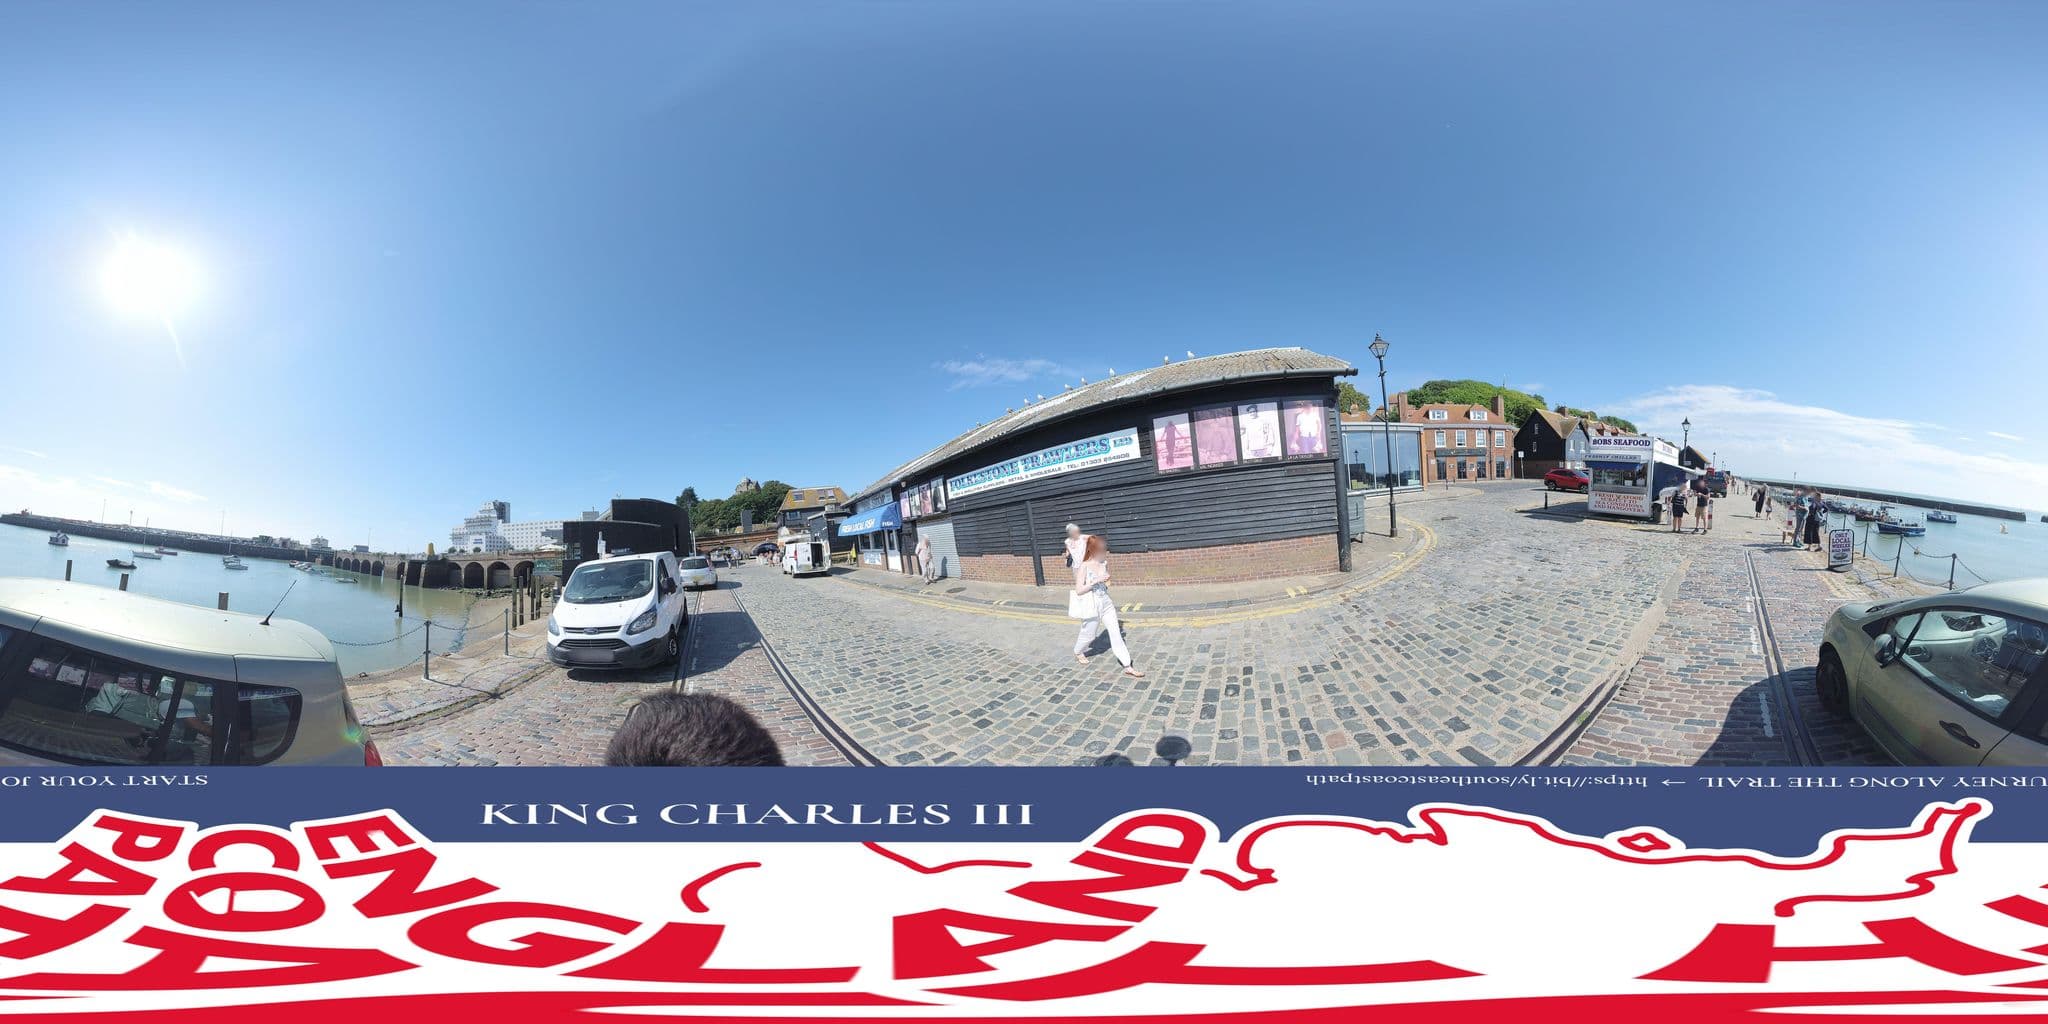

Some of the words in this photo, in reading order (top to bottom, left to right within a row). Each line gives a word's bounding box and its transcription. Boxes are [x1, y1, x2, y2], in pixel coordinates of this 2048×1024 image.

[1613, 438, 1650, 447] SEAFOOD
[950, 461, 1020, 491] FOLKESTONE
[1022, 438, 1111, 472] TRAWLERS
